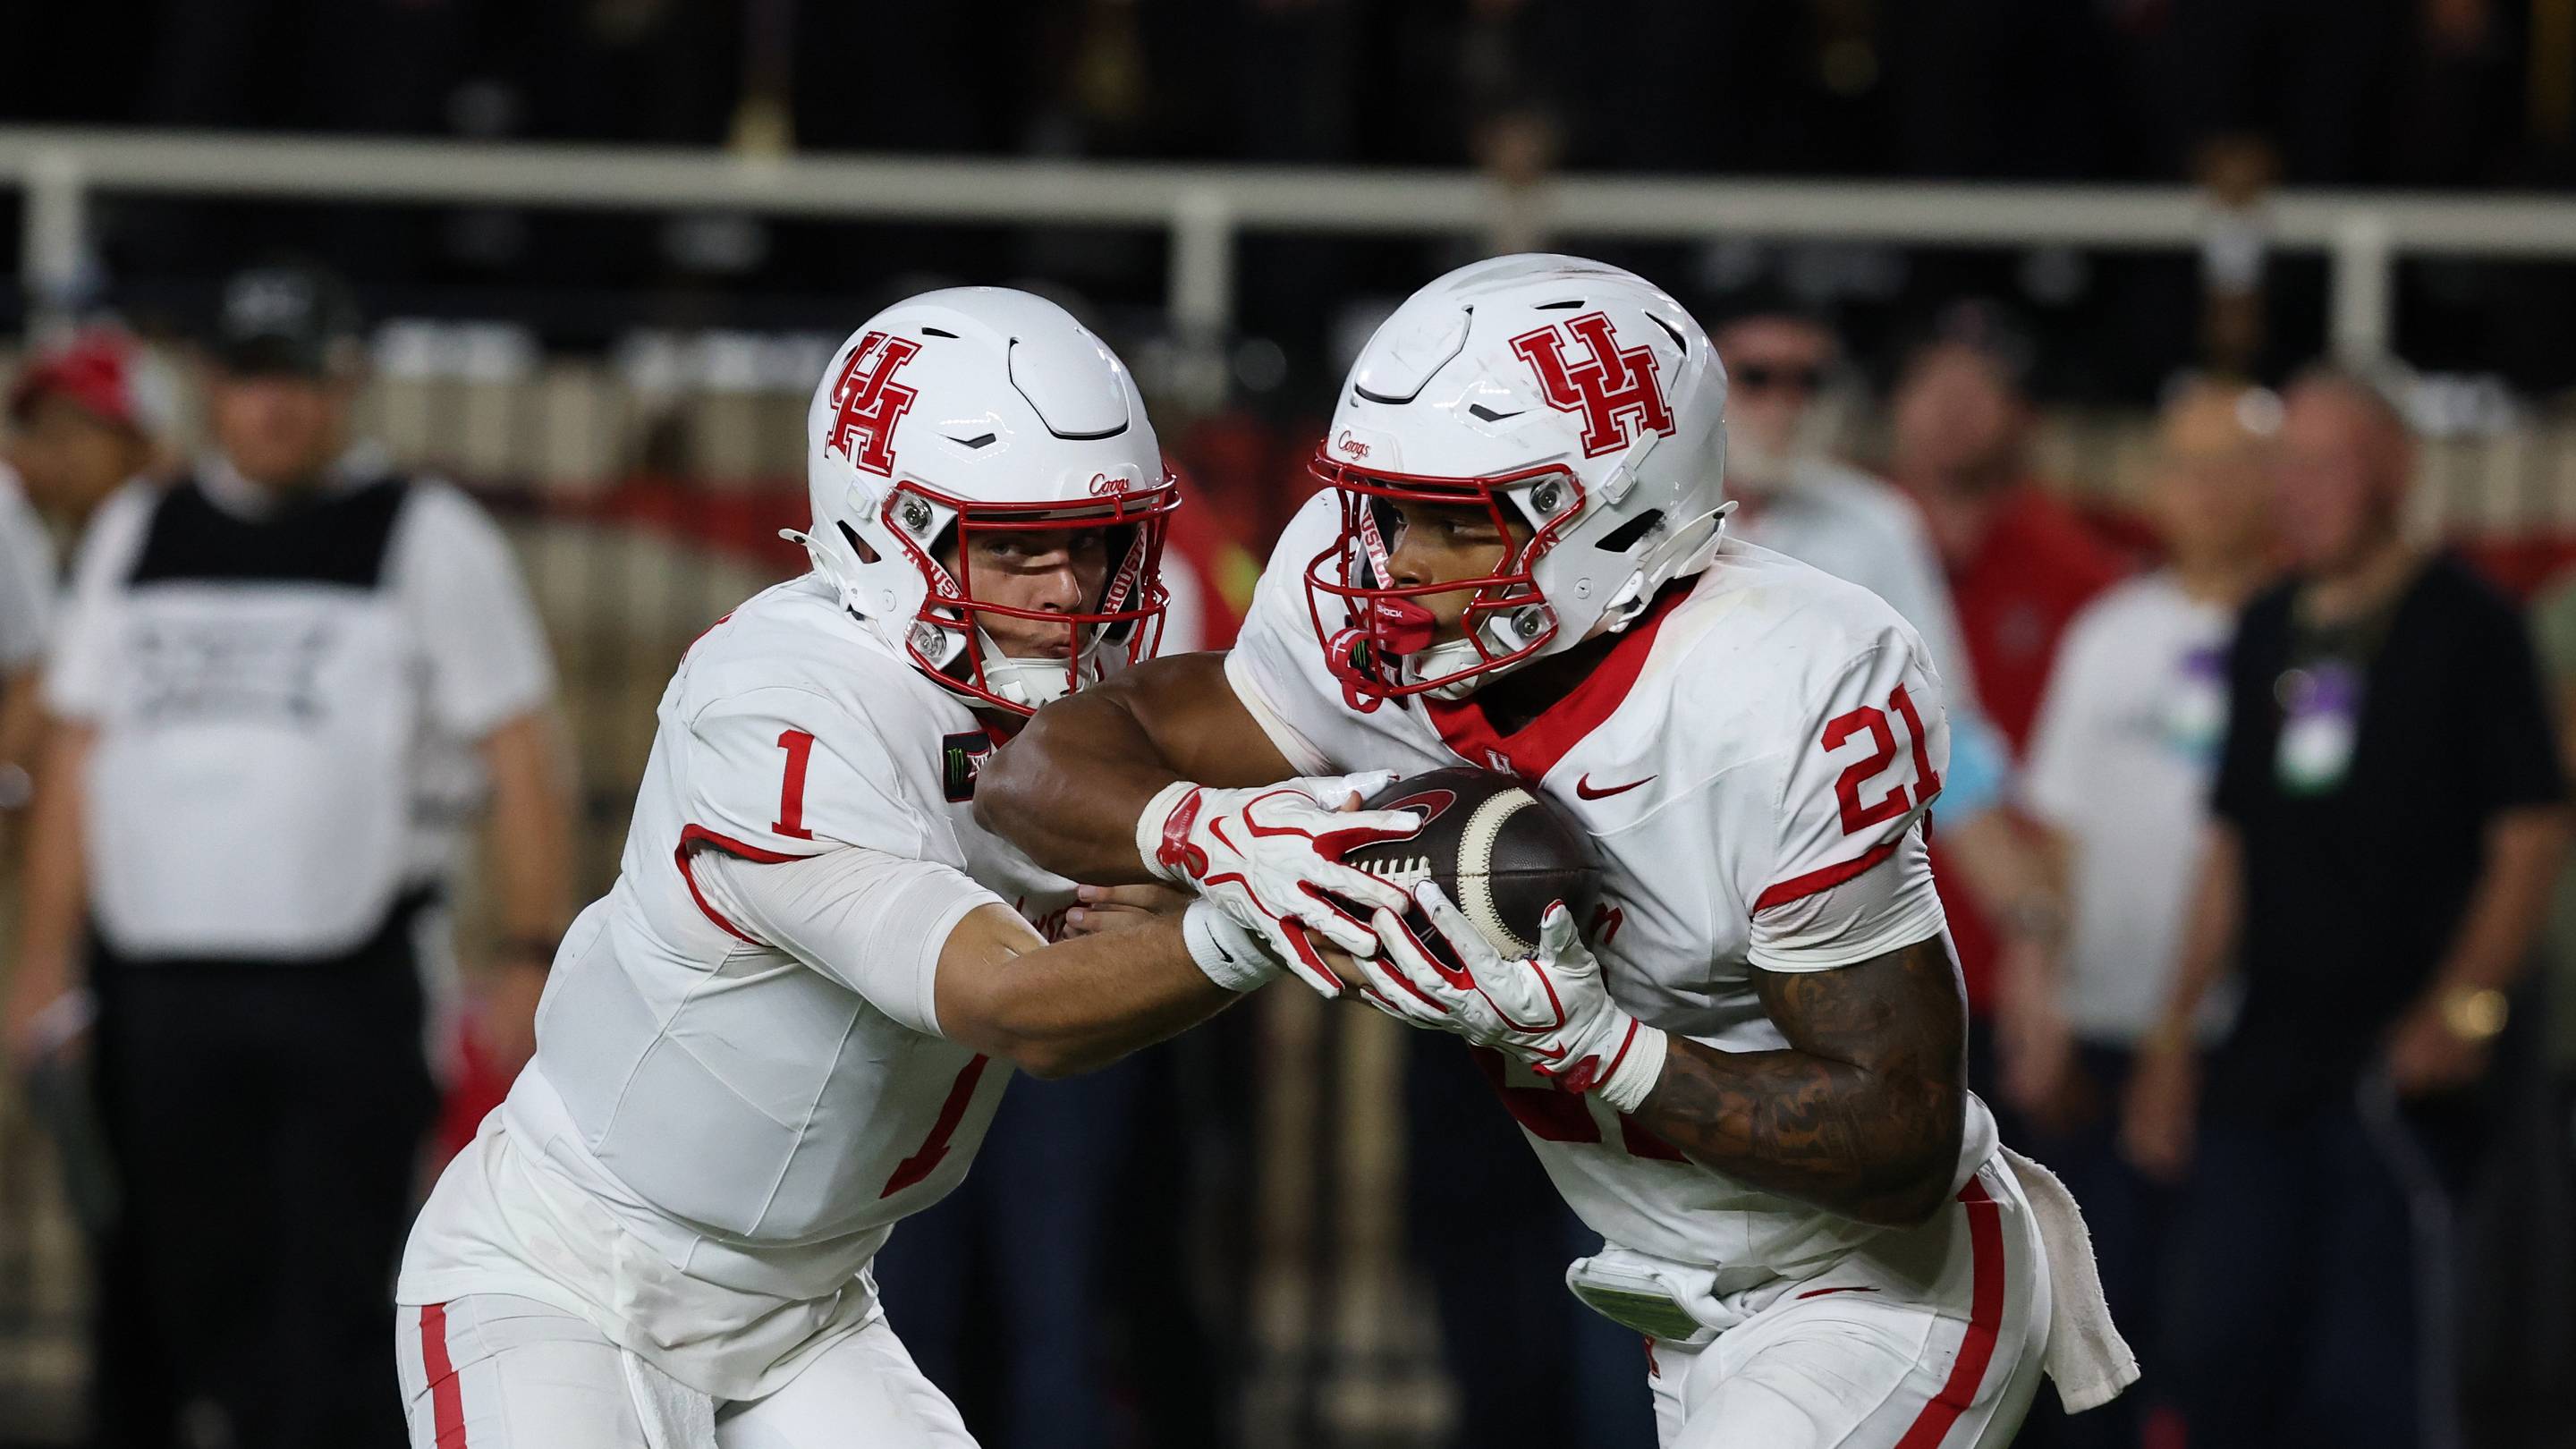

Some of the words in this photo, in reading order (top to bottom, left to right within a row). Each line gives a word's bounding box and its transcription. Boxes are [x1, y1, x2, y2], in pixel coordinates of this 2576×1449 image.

[825, 331, 923, 478] UH
[1338, 430, 1370, 460] Coogs
[1508, 311, 1676, 459] UH
[1089, 473, 1129, 496] Coogs
[772, 729, 815, 840] 1
[1821, 682, 1943, 837] 21
